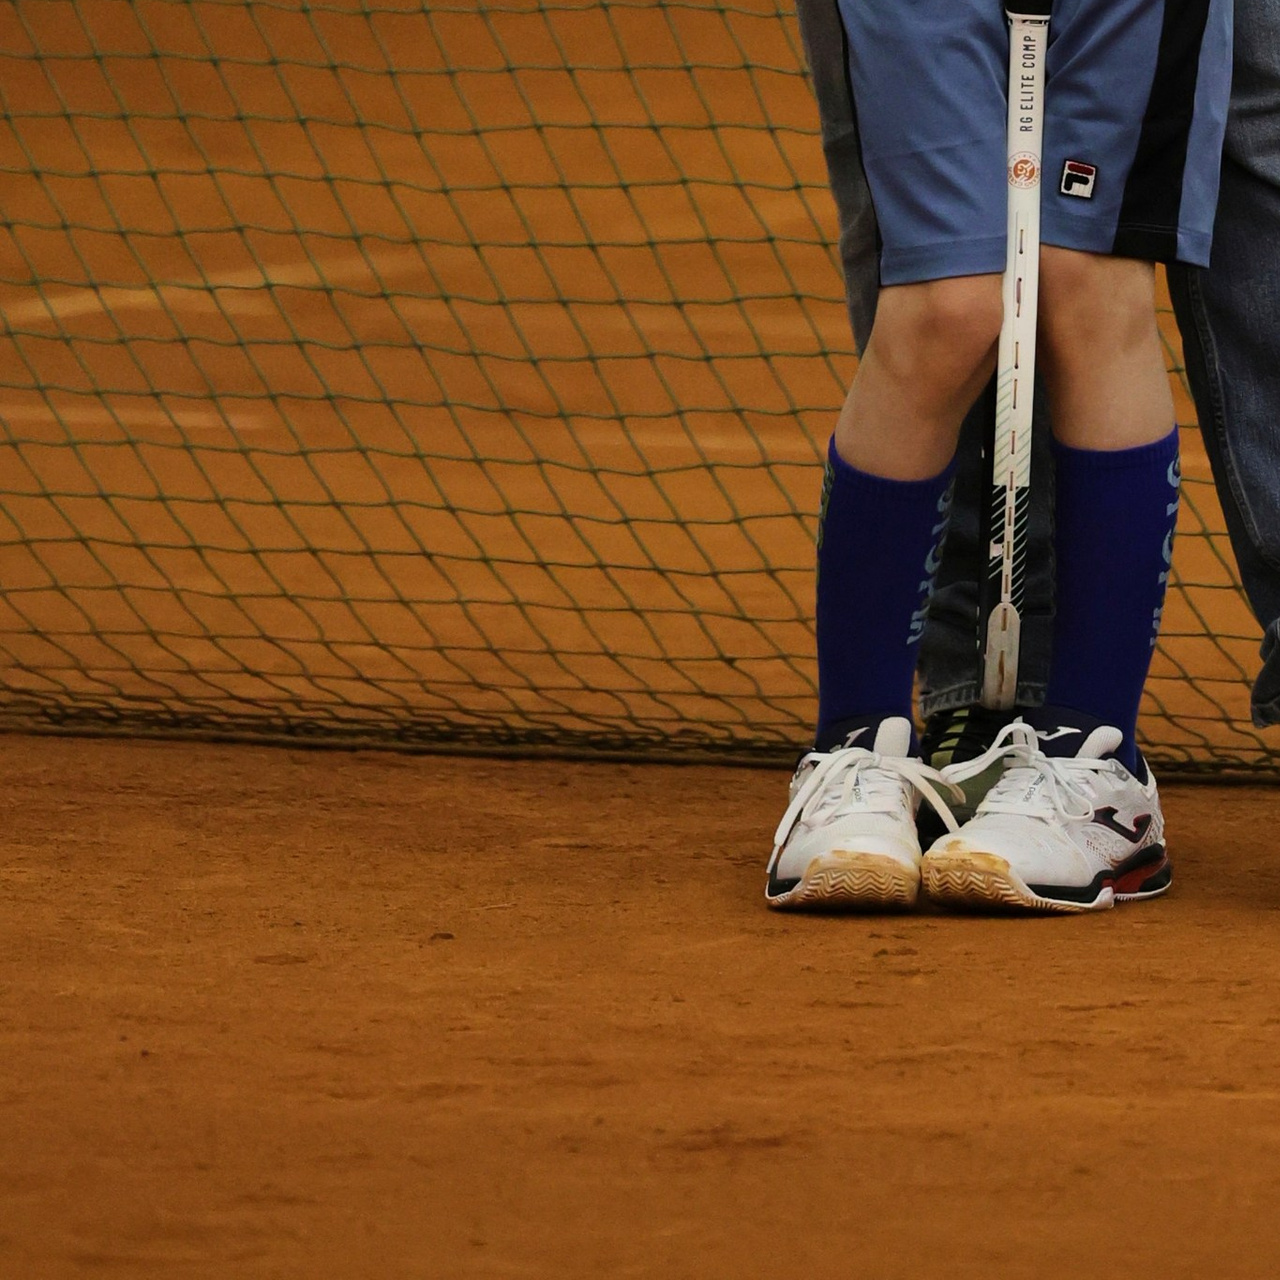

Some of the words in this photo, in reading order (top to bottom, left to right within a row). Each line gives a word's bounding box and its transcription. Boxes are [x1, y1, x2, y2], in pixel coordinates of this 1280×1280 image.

[1022, 35, 1036, 69] COMP
[1020, 74, 1035, 111] ELITE
[1019, 116, 1033, 132] RG
